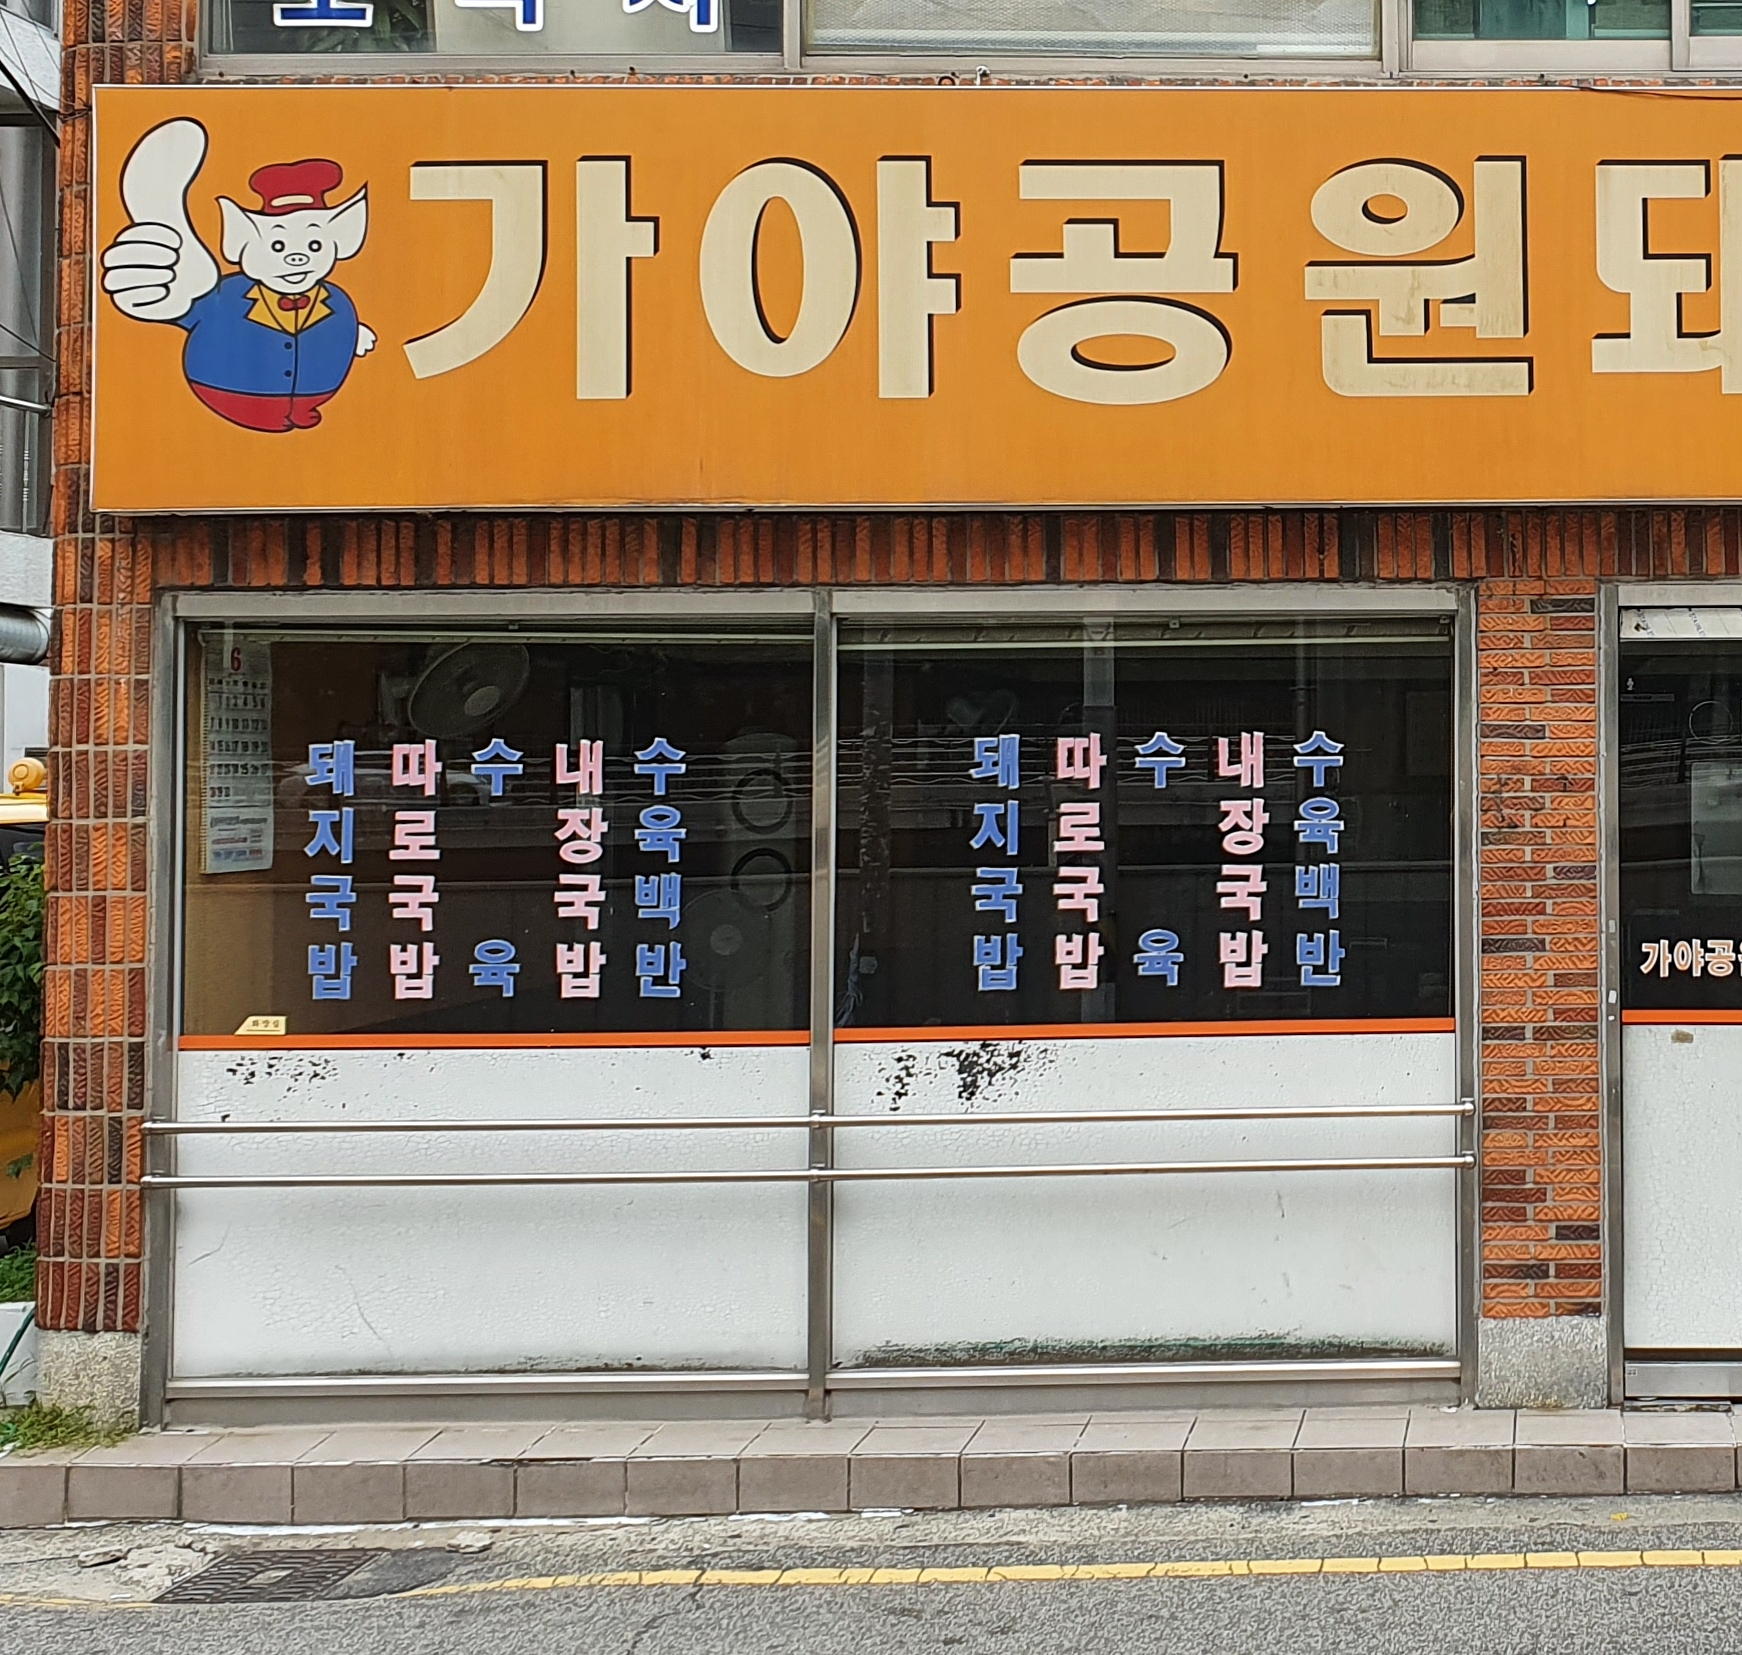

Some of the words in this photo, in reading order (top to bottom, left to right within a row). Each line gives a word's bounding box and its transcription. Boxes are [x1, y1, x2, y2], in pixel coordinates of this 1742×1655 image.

[230, 647, 242, 672] 6
[304, 738, 357, 1001] 돼지국밥
[387, 737, 443, 1001] 따로국밥
[469, 737, 524, 998] 수육
[553, 738, 608, 1000] 내장국밥
[633, 736, 687, 999] 수육백반
[969, 733, 1023, 992] 돼지국밥
[1052, 731, 1107, 991] 따로국밥
[1132, 730, 1186, 987] 수육
[1216, 731, 1270, 990] 내장국밥
[1292, 730, 1346, 988] 수육백반
